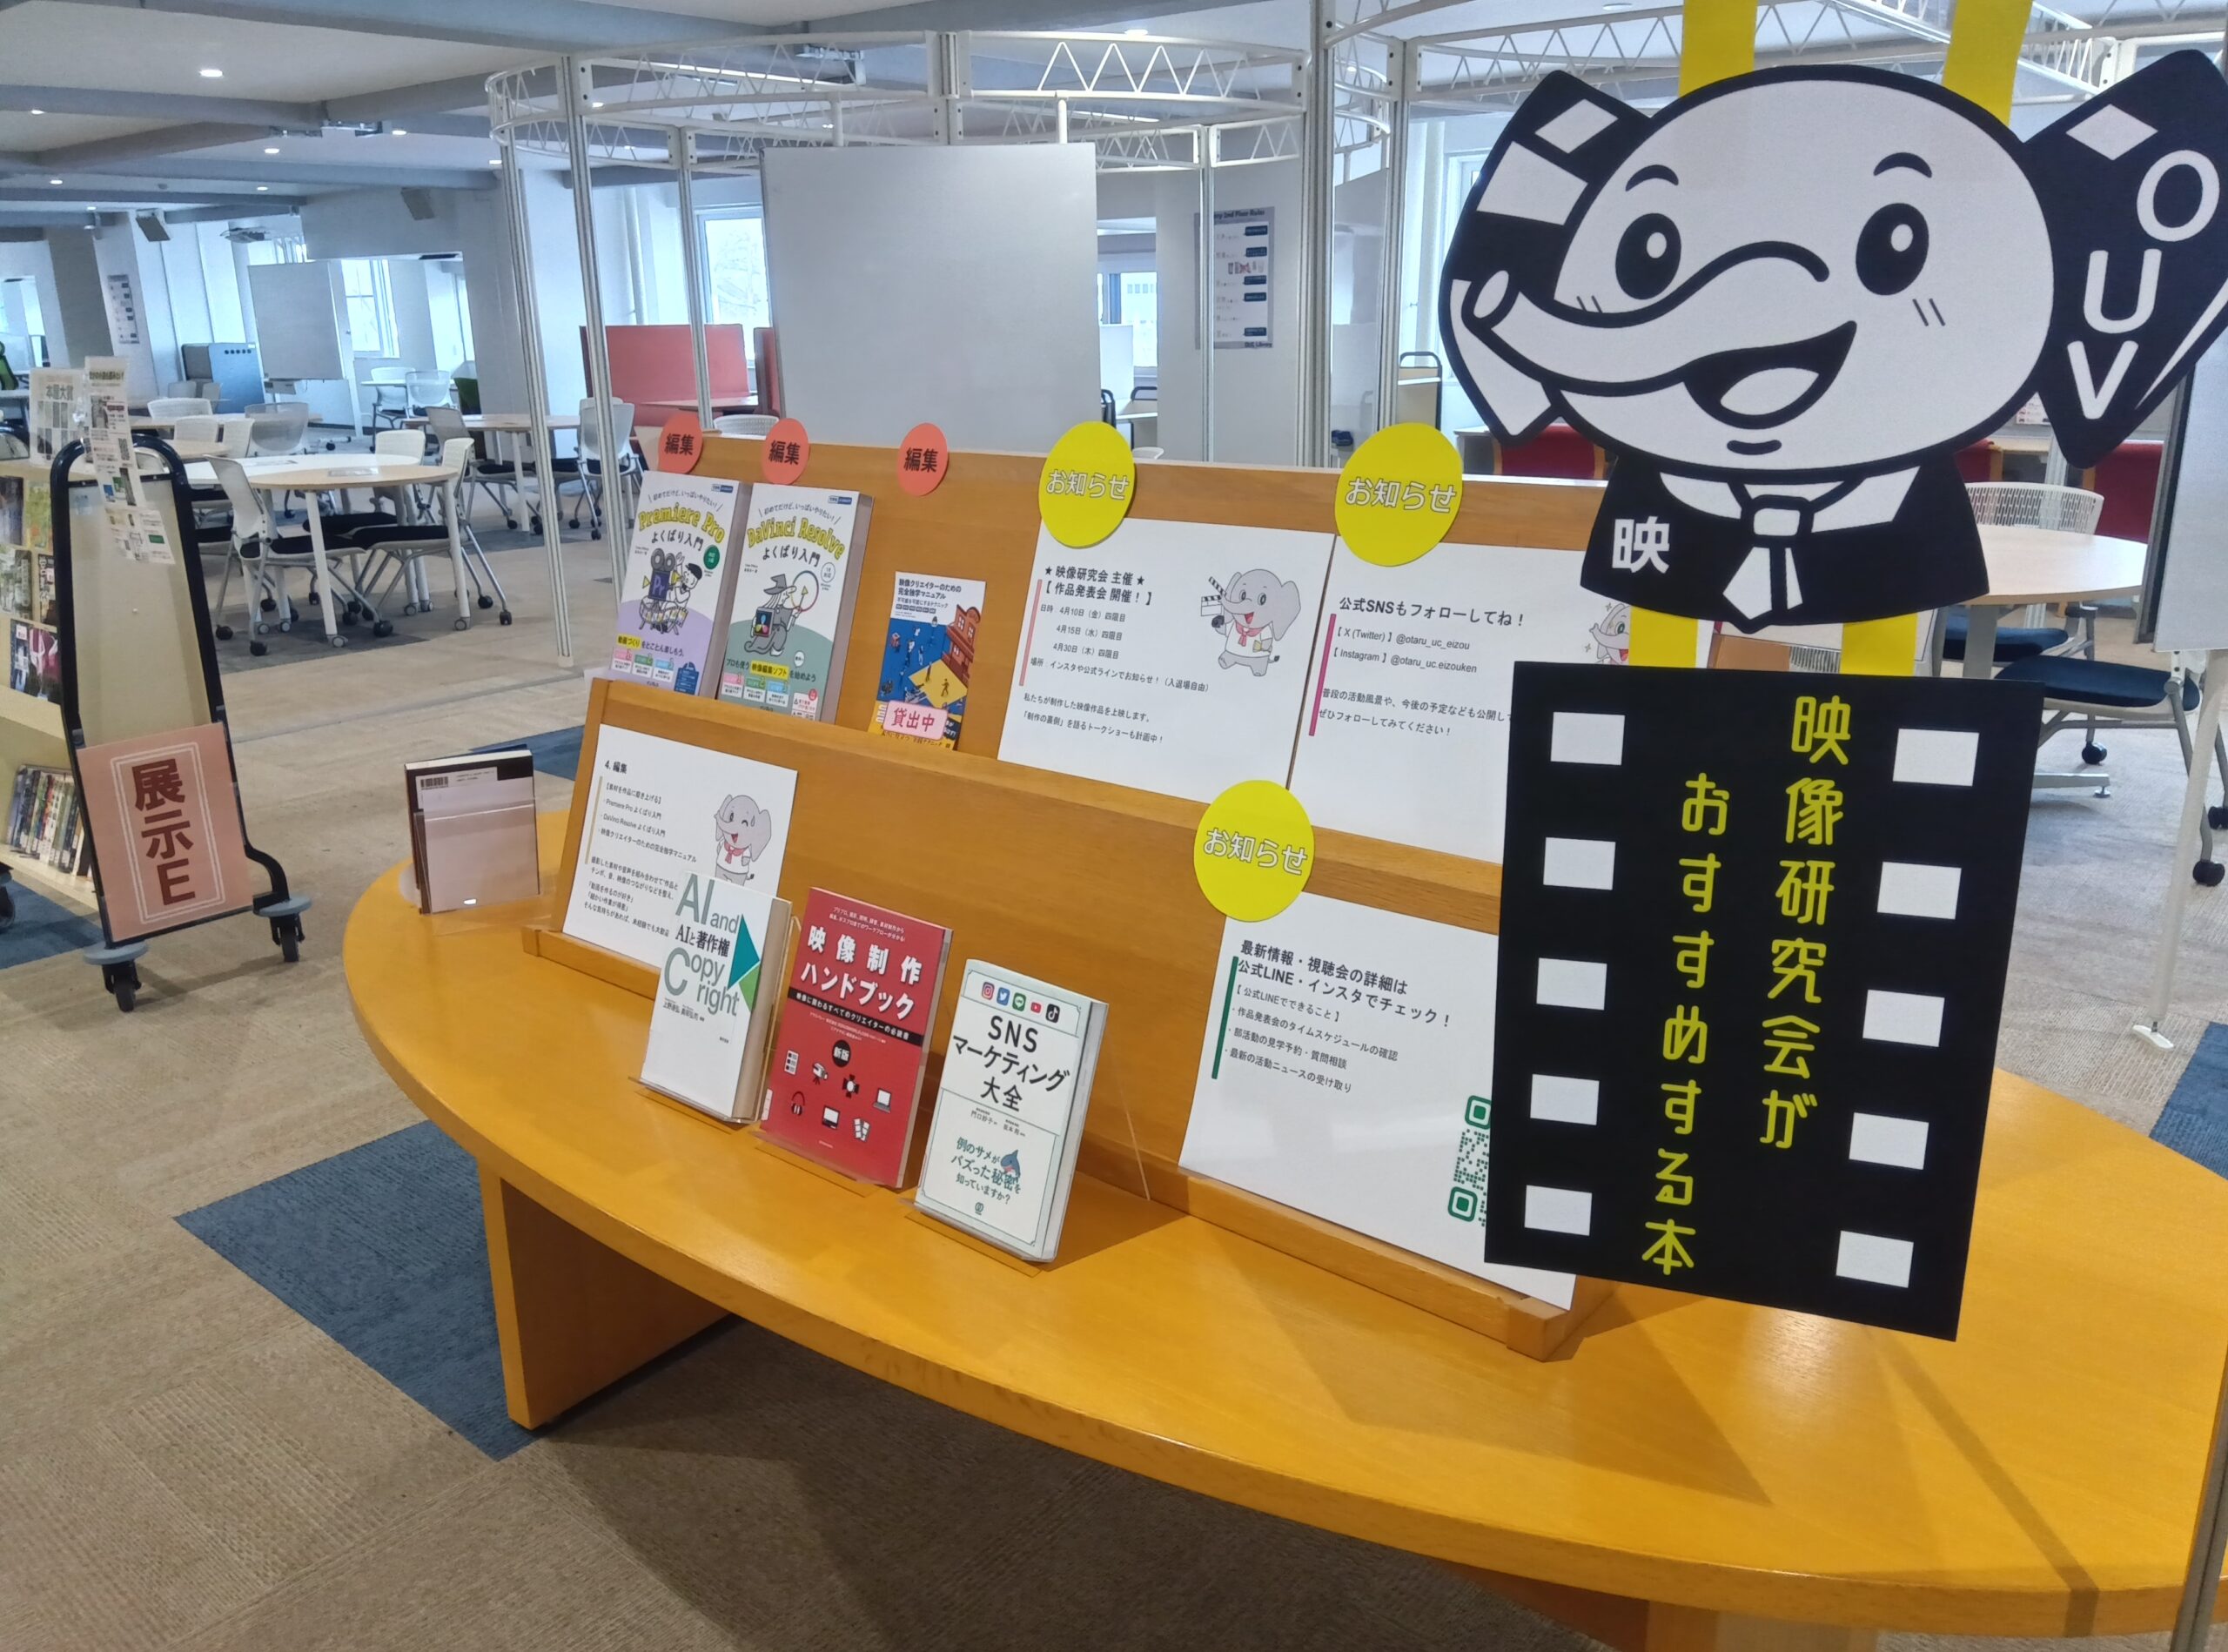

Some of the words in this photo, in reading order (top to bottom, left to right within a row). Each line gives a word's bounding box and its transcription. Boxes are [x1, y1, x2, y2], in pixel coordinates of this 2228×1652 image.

[2067, 150, 2220, 420] OUV
[664, 433, 694, 455] 編集
[768, 440, 801, 465] 編集
[903, 447, 938, 473] 編集
[1046, 469, 1129, 500] お知らせ
[1345, 477, 1455, 513] お知らせ
[638, 502, 701, 531] Premiere
[701, 512, 724, 543] Pro
[651, 529, 703, 551] よくばり入門
[748, 516, 797, 547] DaVinci
[798, 518, 845, 561] Resolve
[1612, 515, 1669, 574] 映
[762, 544, 821, 567] よくばり入門
[653, 576, 665, 595] Pr
[899, 578, 962, 593] 映像クリエイターのための
[1055, 566, 1109, 583] 映像研究会
[1111, 570, 1134, 586] 主催
[1055, 582, 1107, 600] 作品発表会
[897, 588, 946, 600] 完全独学マニュアル
[1040, 604, 1054, 613] 日時
[1339, 596, 1524, 627] 公式SNSもフォローしてね！
[1352, 629, 1386, 642] (Twitter)
[1396, 635, 1470, 650] @otaru_uc_eizou
[1030, 657, 1044, 667] 場所
[1340, 649, 1380, 662] Instagram
[891, 707, 935, 732] 貸出中
[1319, 709, 1451, 736] ぜひフォローしてみてください！
[613, 762, 627, 774] 編集
[634, 805, 661, 820] よくばり入門
[131, 758, 196, 906] 展示E
[637, 823, 666, 838] よくばり入門
[1203, 828, 1307, 876] お知らせ
[675, 873, 715, 925] AI
[710, 911, 740, 934] and
[1759, 695, 1852, 1150] 映像研究会が
[675, 923, 730, 958] AIと著作権
[807, 924, 923, 986] 映像制作
[1240, 940, 1408, 996] 最新情報・視聴会の詳細は
[696, 982, 740, 1017] right
[800, 962, 915, 1021] ハンドブック
[1238, 959, 1450, 1027] 公式LINE・インスタでチェック！
[988, 1015, 1038, 1053] SNS
[1641, 772, 1730, 1276] おすすめする本
[834, 1046, 850, 1063] 新版
[952, 1035, 1070, 1092] マーケティング
[981, 1076, 1023, 1112] 大全
[956, 1137, 1000, 1164] 例のサメが
[951, 1155, 1022, 1194] バズった秘密を
